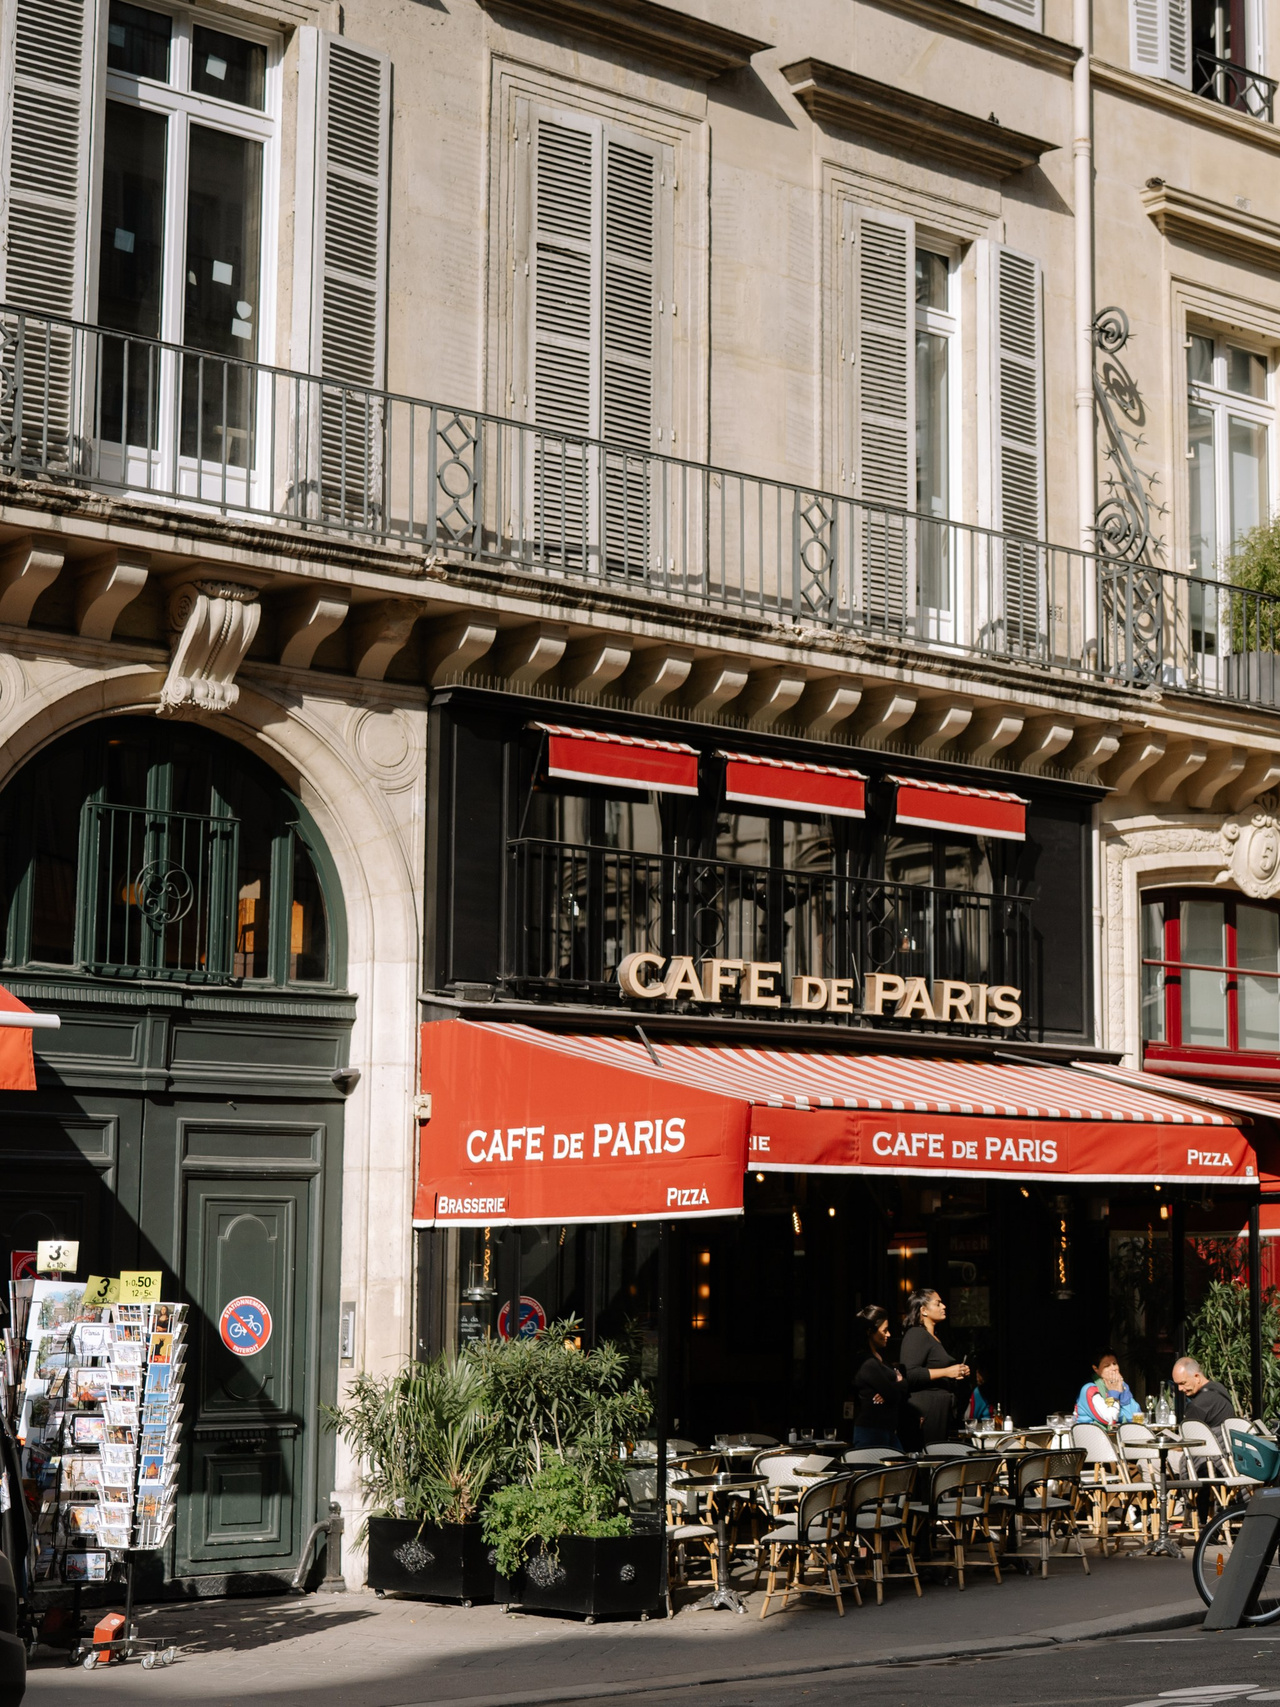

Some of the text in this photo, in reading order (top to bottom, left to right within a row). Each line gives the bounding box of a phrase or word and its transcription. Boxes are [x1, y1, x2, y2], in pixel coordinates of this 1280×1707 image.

[617, 951, 1022, 1028] CAFE DE PARIS
[466, 1117, 686, 1163] CAFE DE PARIS
[749, 1135, 770, 1152] IE
[872, 1131, 1058, 1164] CAFE DE PARIS
[1187, 1149, 1233, 1167] PIZZA
[437, 1195, 506, 1215] BRASSERIE
[666, 1187, 710, 1207] PIZZA
[224, 1299, 267, 1318] STATIONNEMENT
[232, 1344, 259, 1353] INTERDIT
